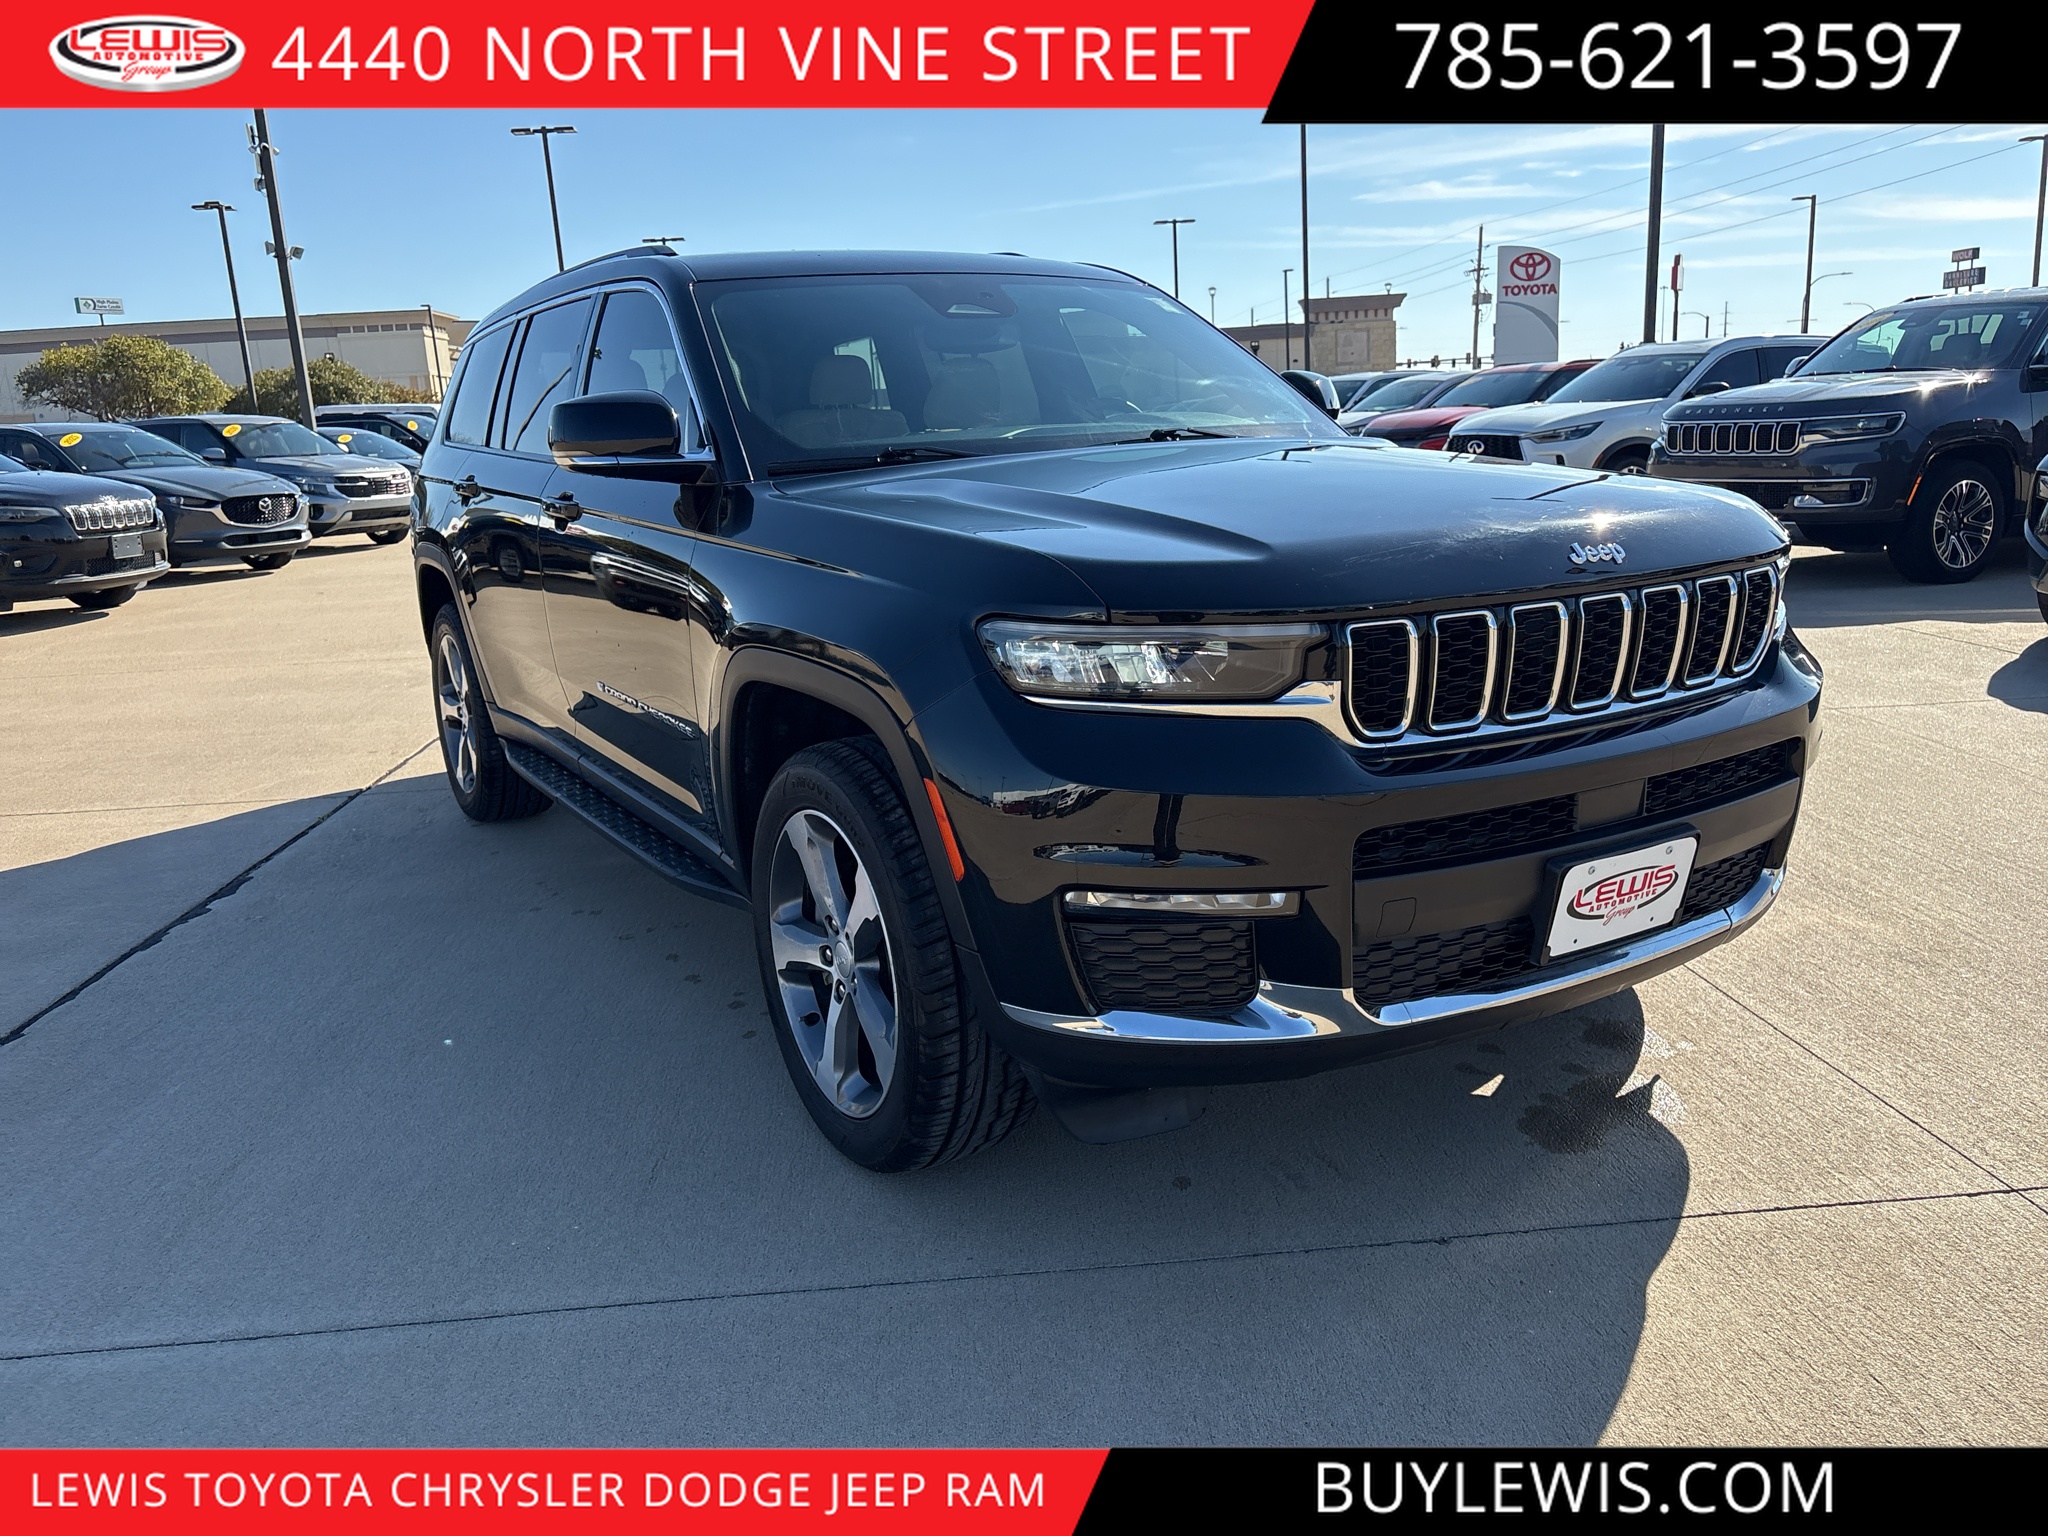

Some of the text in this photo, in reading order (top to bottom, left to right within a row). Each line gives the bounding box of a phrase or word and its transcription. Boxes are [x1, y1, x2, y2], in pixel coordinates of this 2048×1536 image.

[1502, 283, 1557, 297] TOYOTA
[1685, 405, 1785, 415] WAGONEER
[1568, 542, 1626, 565] Jeep
[1574, 864, 1676, 909] LEWIS
[1588, 888, 1657, 913] AUTOMOTIVE
[1602, 905, 1636, 926] Group
